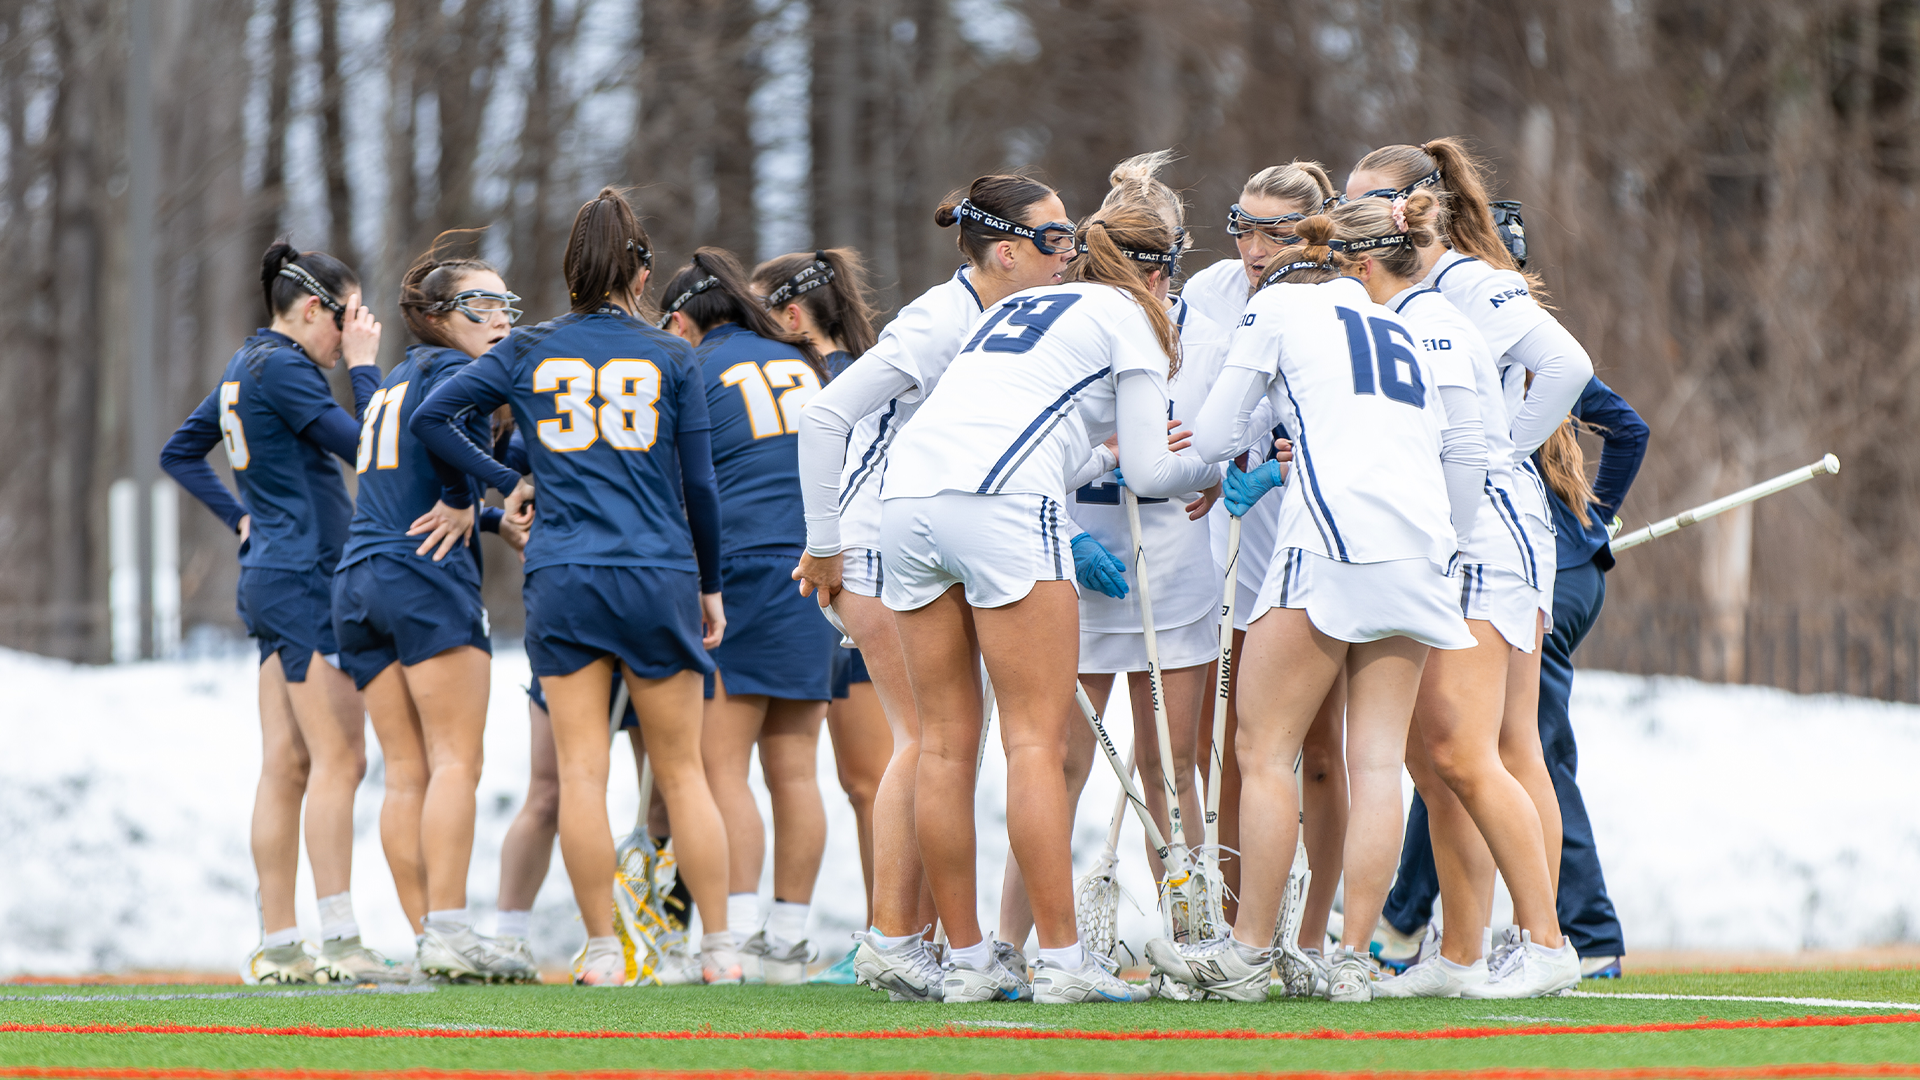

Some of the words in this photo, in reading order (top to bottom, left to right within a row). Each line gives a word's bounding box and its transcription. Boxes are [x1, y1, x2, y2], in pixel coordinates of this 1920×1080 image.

[984, 217, 1011, 231] GAIT
[1014, 226, 1036, 239] GAI
[1350, 239, 1377, 250] GAIT
[1381, 235, 1405, 245] GAIT
[795, 266, 817, 283] STX
[1138, 252, 1160, 261] GAIT
[1269, 264, 1291, 283] GAIT
[1292, 261, 1318, 270] GAIT
[672, 289, 693, 311] STX
[798, 278, 821, 294] STX
[960, 293, 1082, 355] 19
[1334, 305, 1426, 410] 16
[533, 357, 662, 452] 38
[719, 358, 823, 440] 12
[218, 380, 251, 471] 5
[356, 380, 409, 475] 31
[1220, 647, 1231, 699] HAWKS
[1091, 713, 1117, 757] HAWKS
